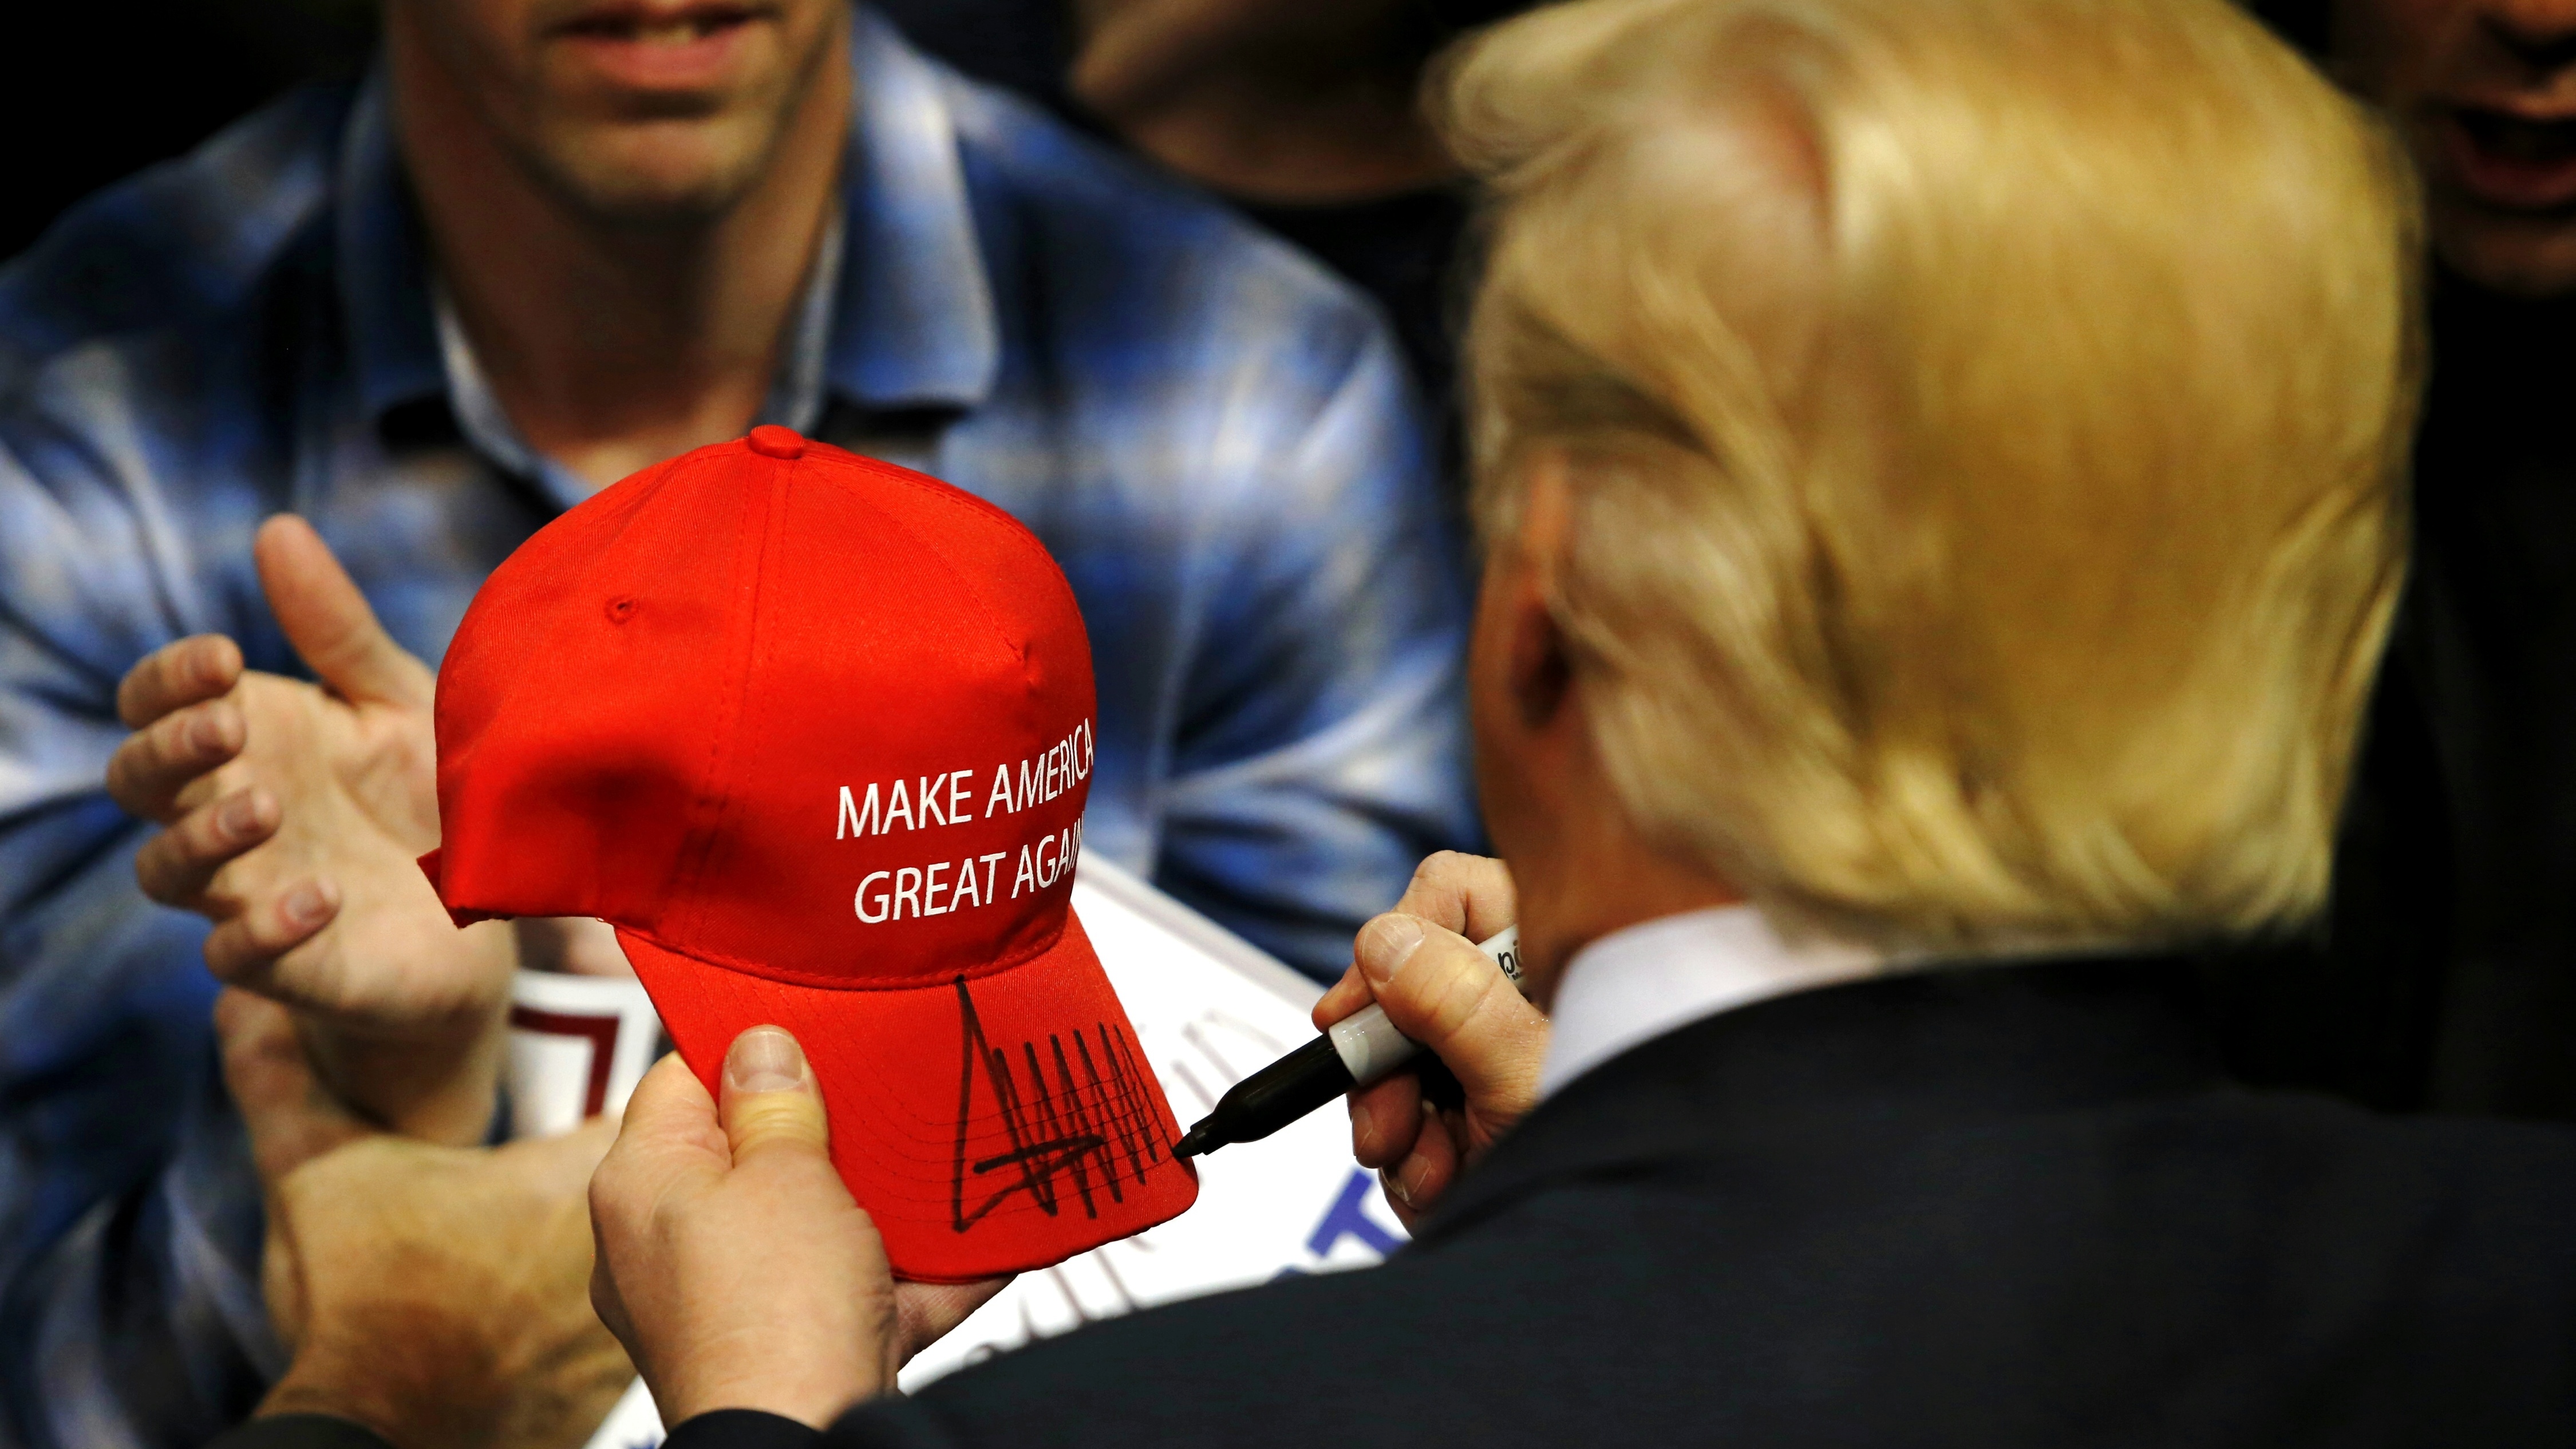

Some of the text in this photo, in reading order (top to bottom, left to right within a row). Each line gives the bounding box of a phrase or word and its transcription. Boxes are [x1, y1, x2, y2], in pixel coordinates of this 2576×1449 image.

[836, 718, 1093, 840] MAKE AMERICA
[855, 852, 1006, 924] GREAT
